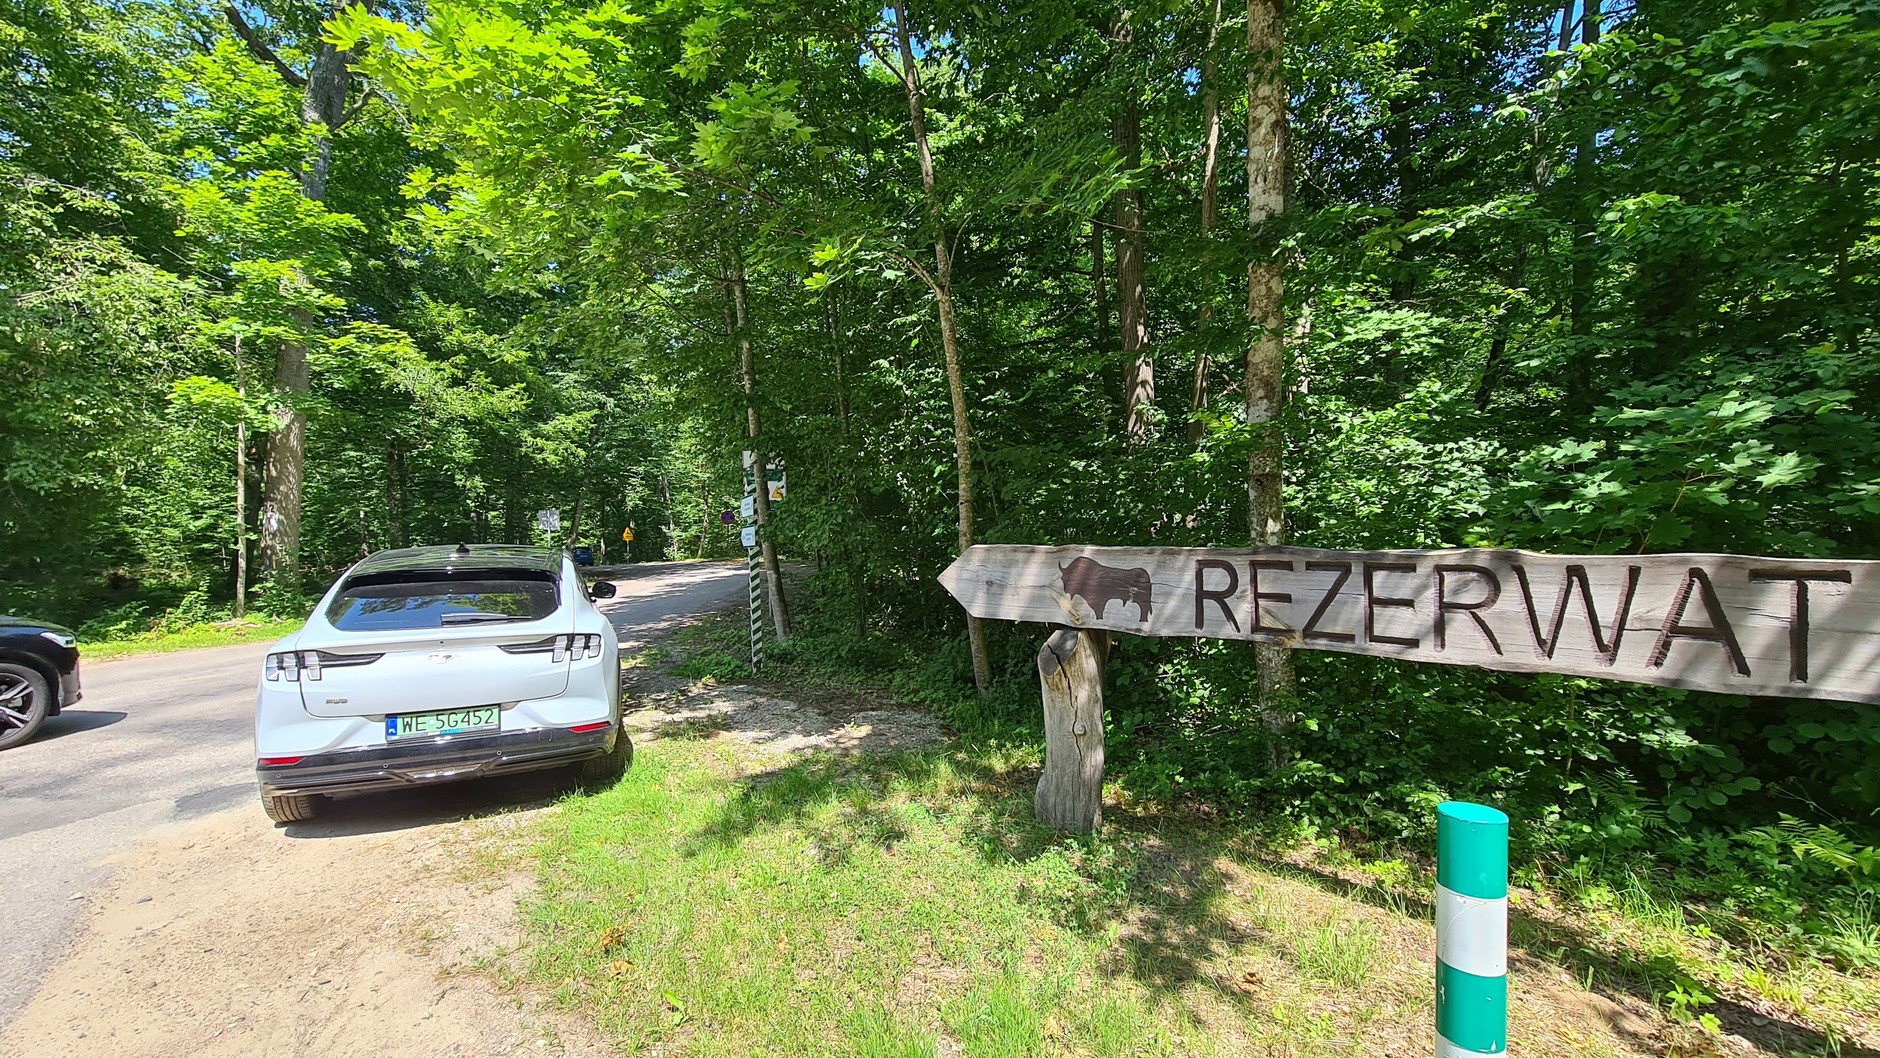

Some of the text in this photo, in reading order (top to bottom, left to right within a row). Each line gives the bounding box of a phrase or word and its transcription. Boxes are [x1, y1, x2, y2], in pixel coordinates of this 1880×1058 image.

[1195, 559, 1851, 684] REZERWAT
[402, 709, 494, 733] WE 5G452
